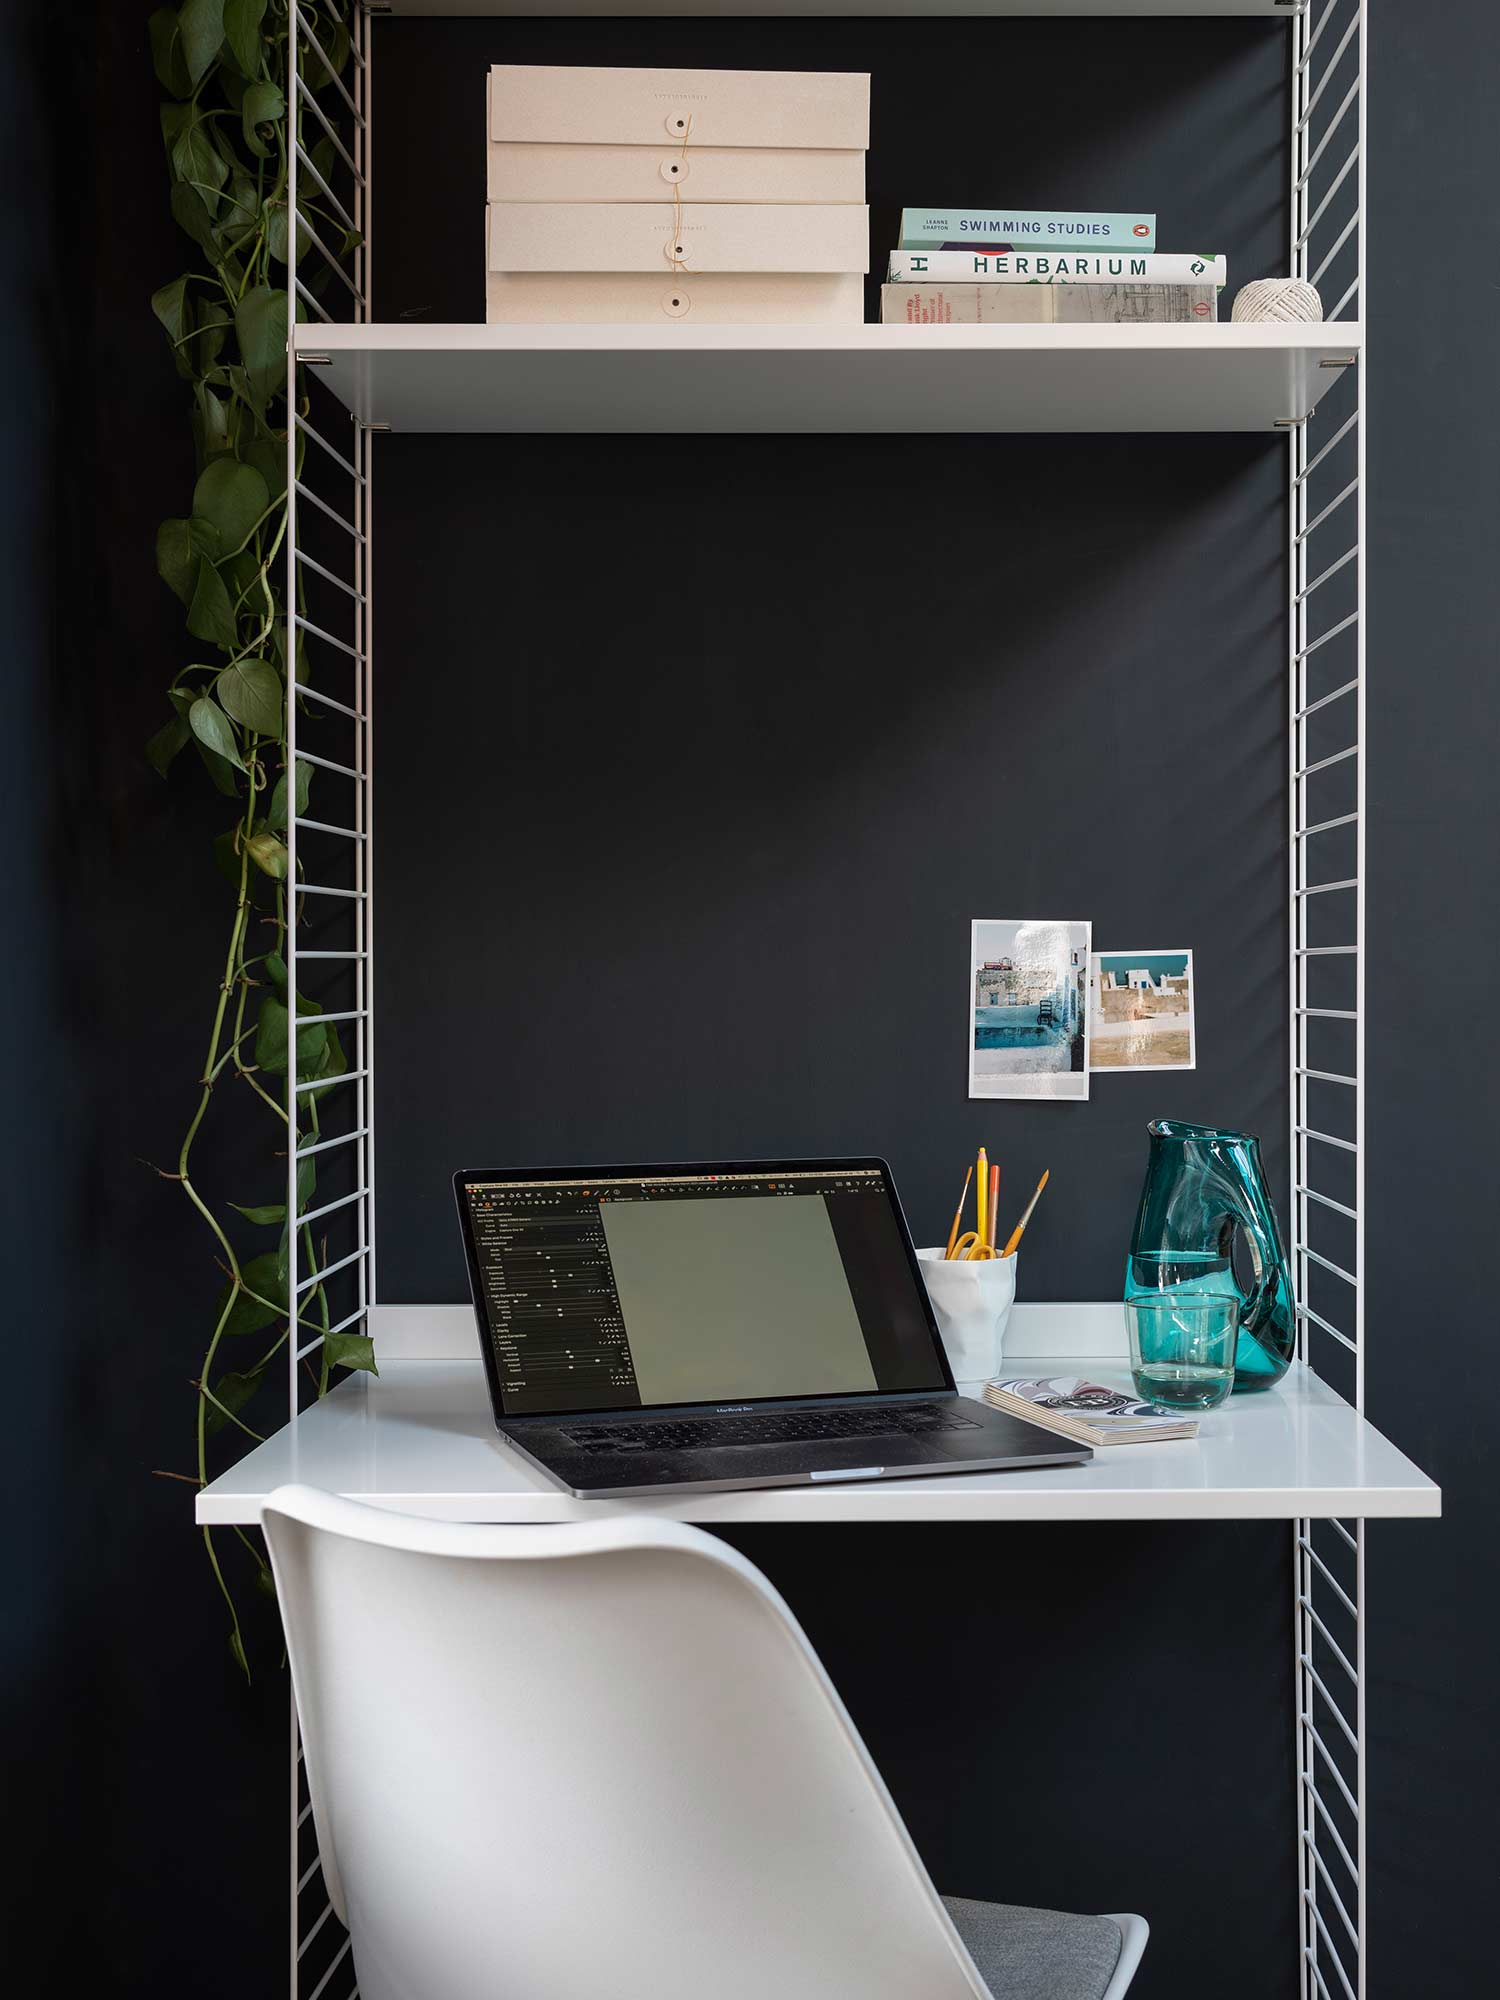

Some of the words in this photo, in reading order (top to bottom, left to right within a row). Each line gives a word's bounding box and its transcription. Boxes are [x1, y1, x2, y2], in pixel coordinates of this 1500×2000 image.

[959, 219, 1042, 234] SWIMMING
[1047, 222, 1111, 236] STUDIES
[910, 257, 928, 272] H
[974, 257, 1147, 276] HERBARIUM
